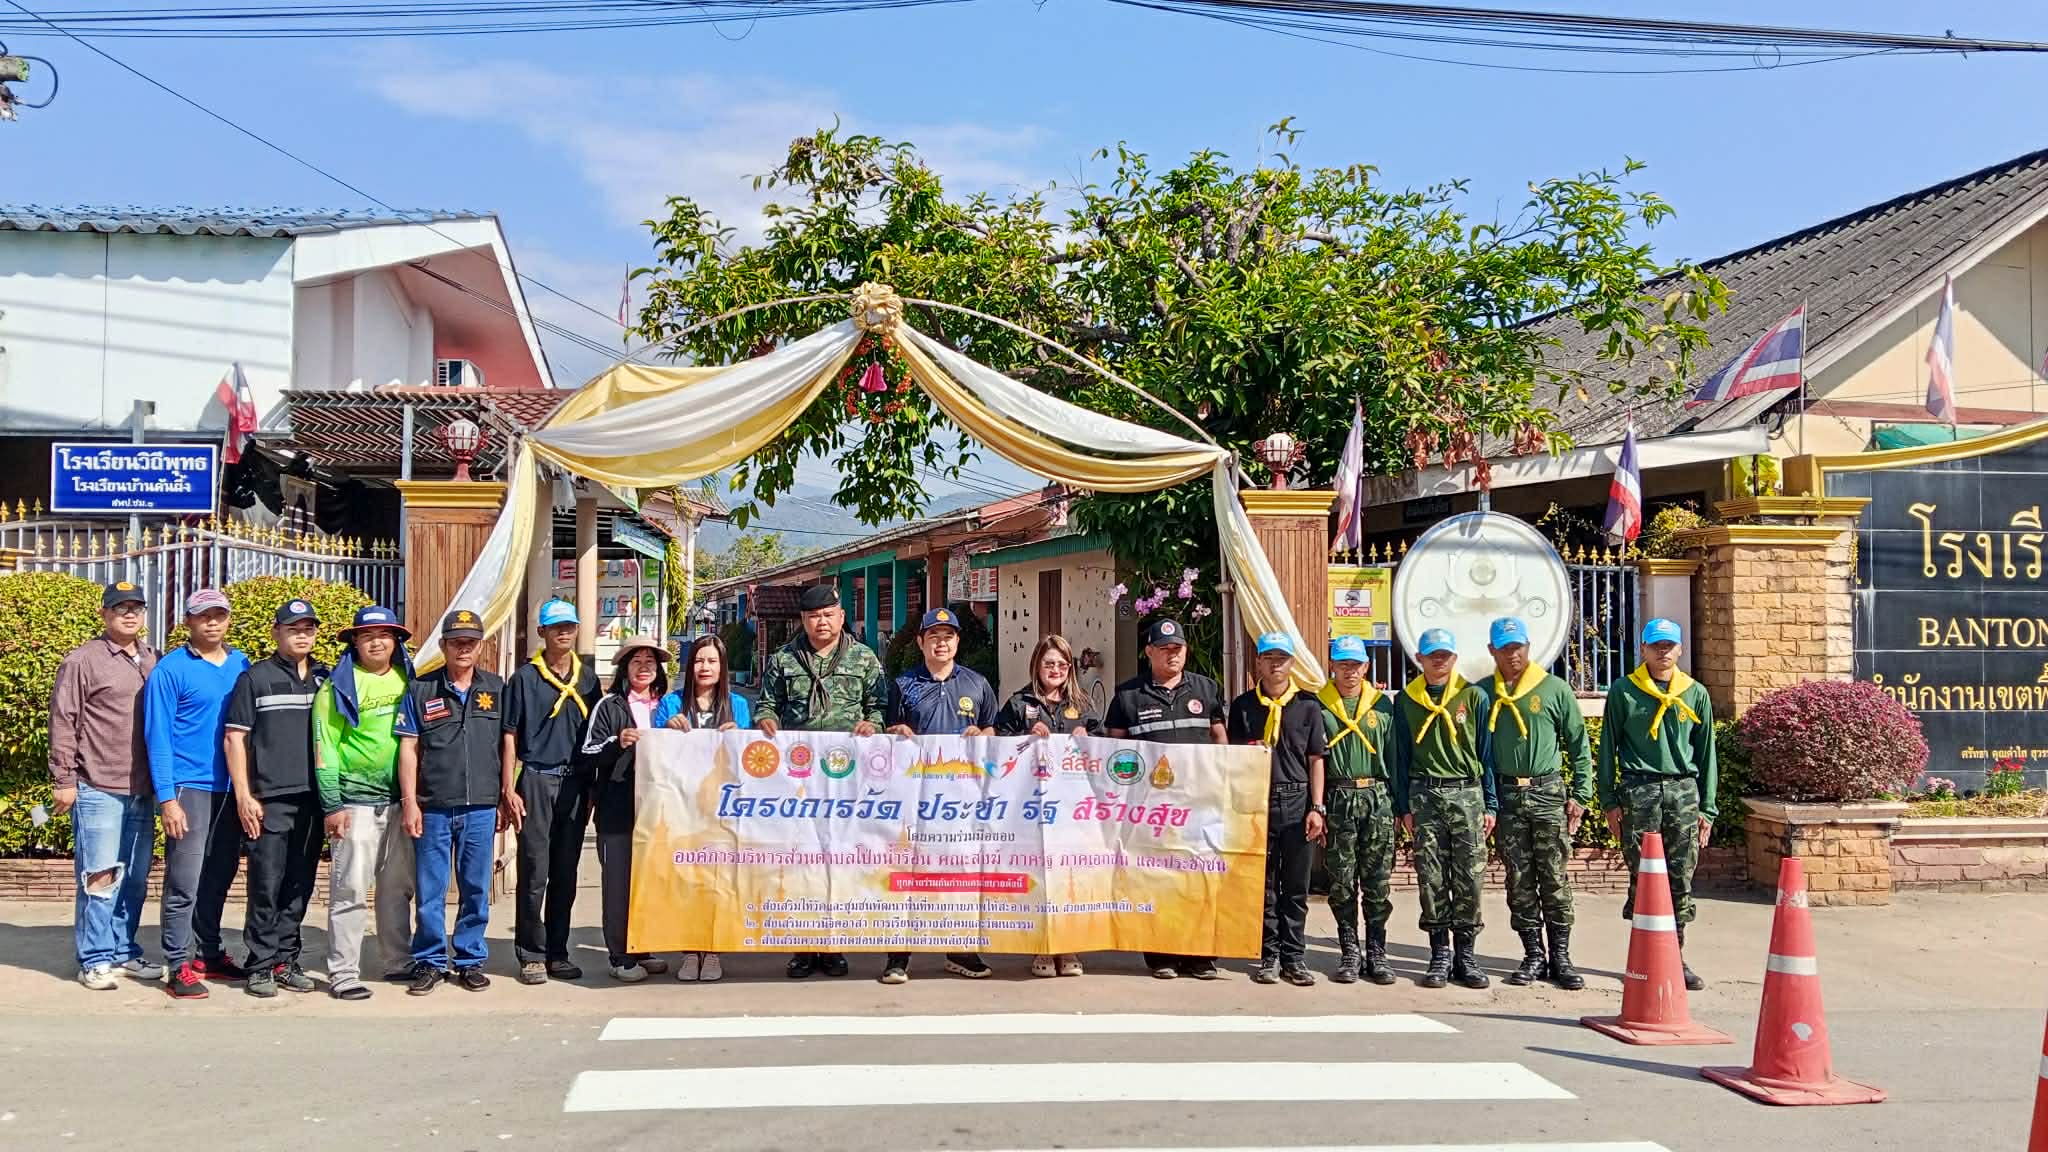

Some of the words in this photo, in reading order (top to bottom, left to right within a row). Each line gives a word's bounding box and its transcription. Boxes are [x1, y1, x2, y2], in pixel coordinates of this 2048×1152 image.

[58, 448, 208, 478] โรงเรียนวิถีพุทธ
[72, 474, 192, 493] โรงเรียนบ้านต้นผึ้ง
[718, 783, 902, 820] โครงการวัด
[917, 793, 1008, 821] ประชา
[1023, 789, 1061, 825] รัฐ
[1072, 791, 1192, 837] สร้างสุข
[906, 827, 1015, 842] โดยความร่วมมือของ
